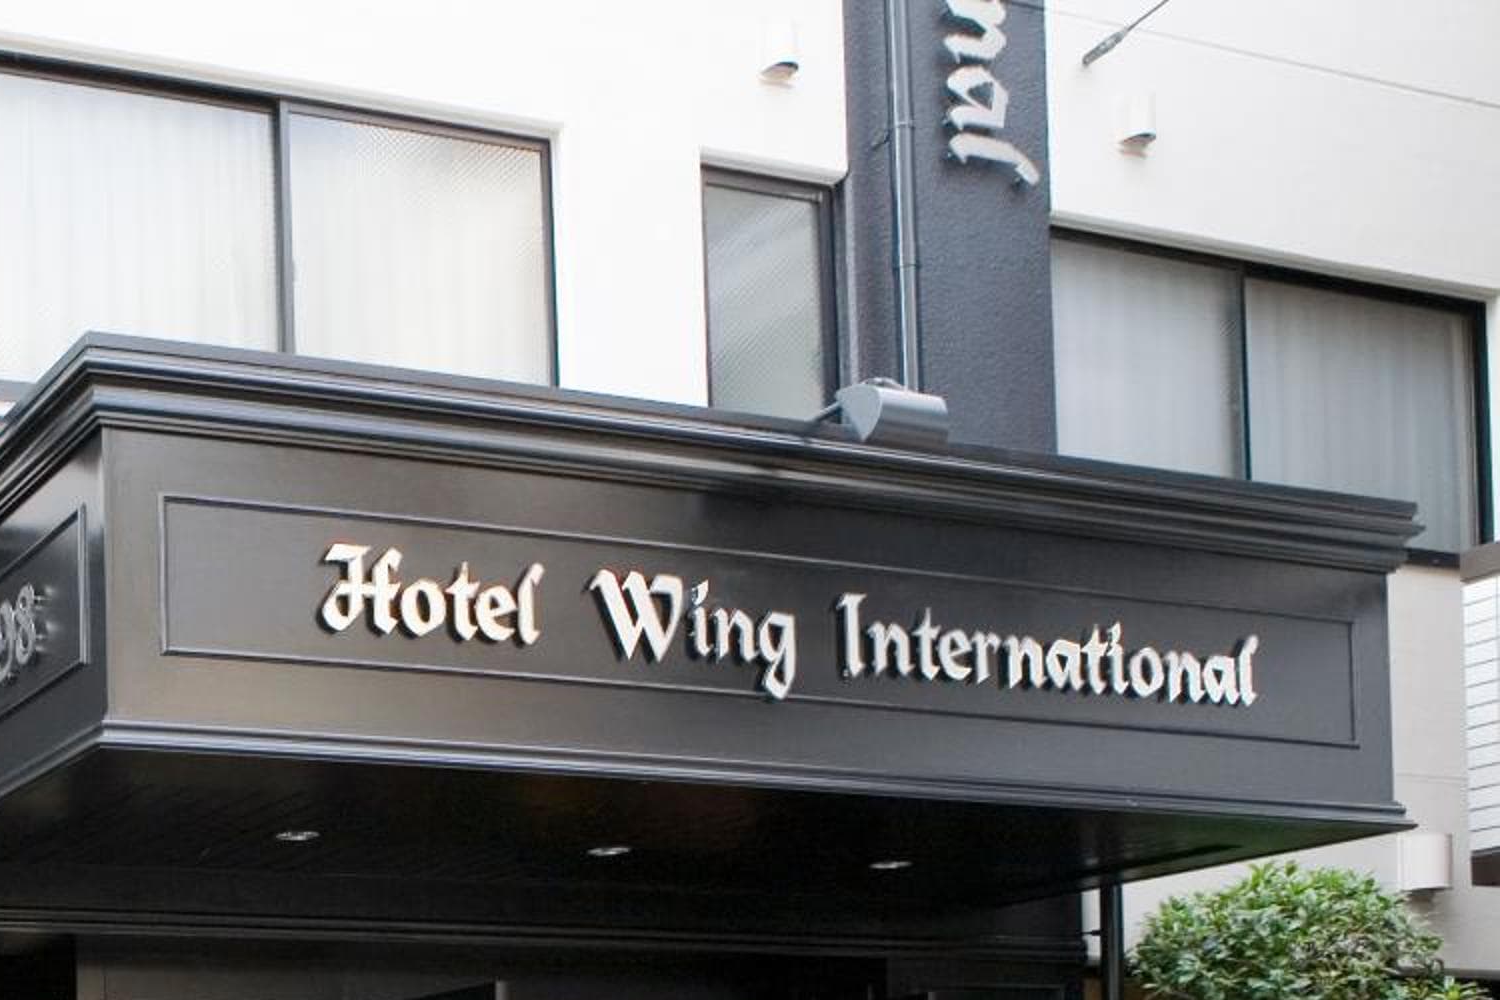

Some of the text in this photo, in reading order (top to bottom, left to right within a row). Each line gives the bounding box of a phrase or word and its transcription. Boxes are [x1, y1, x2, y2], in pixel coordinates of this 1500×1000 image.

[321, 542, 1260, 706] Hotel Wing International
